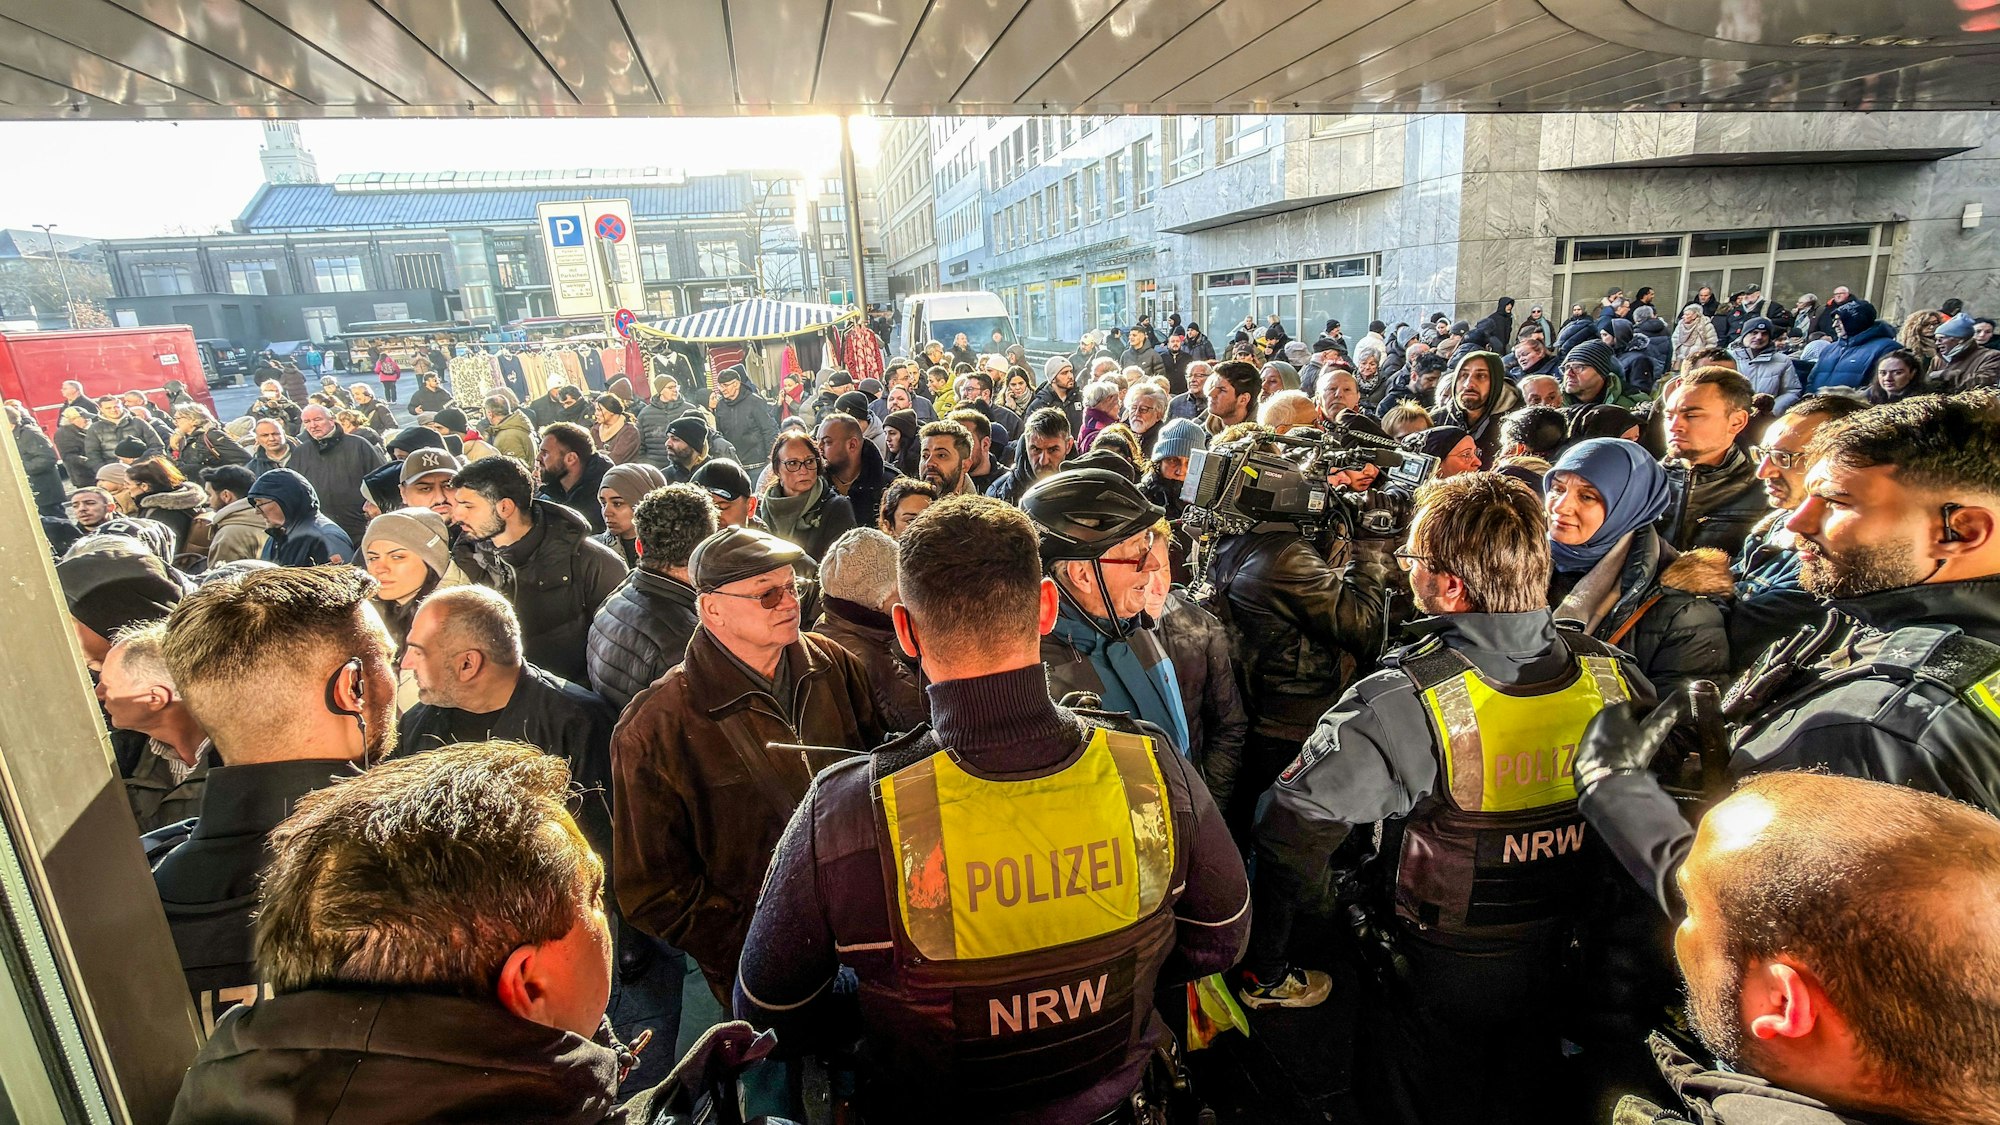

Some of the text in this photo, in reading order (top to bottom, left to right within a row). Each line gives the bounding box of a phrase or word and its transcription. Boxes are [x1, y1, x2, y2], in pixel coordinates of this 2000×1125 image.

[1502, 821, 1586, 863] NRW
[965, 837, 1123, 912] POLIZEI
[988, 972, 1108, 1036] NRW
